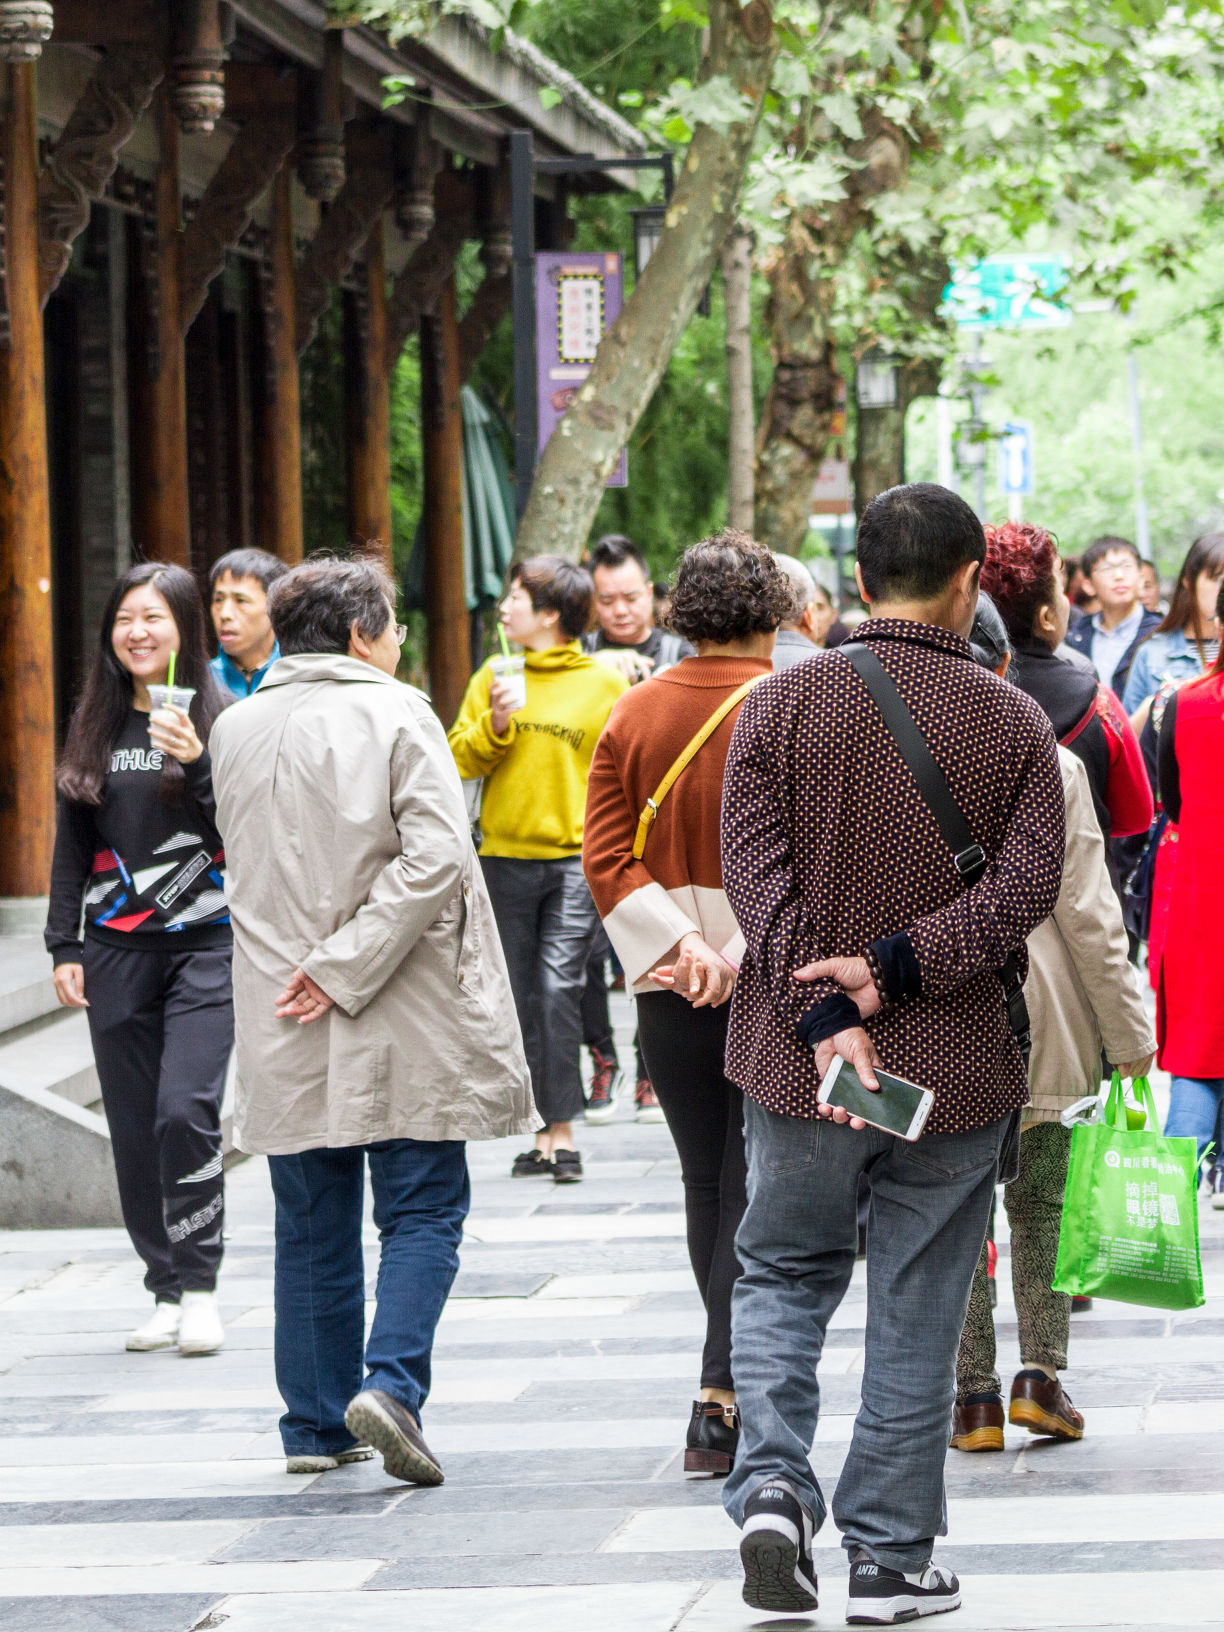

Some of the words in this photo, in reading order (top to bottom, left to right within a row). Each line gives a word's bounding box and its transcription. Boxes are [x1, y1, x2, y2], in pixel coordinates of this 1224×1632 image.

[111, 748, 167, 772] THLE
[1126, 1180, 1159, 1199] 摘掉
[1125, 1199, 1160, 1217] 眼镜
[1126, 1214, 1159, 1230] 不是梦
[759, 1488, 784, 1500] ANTA
[856, 1565, 879, 1577] ANTA
